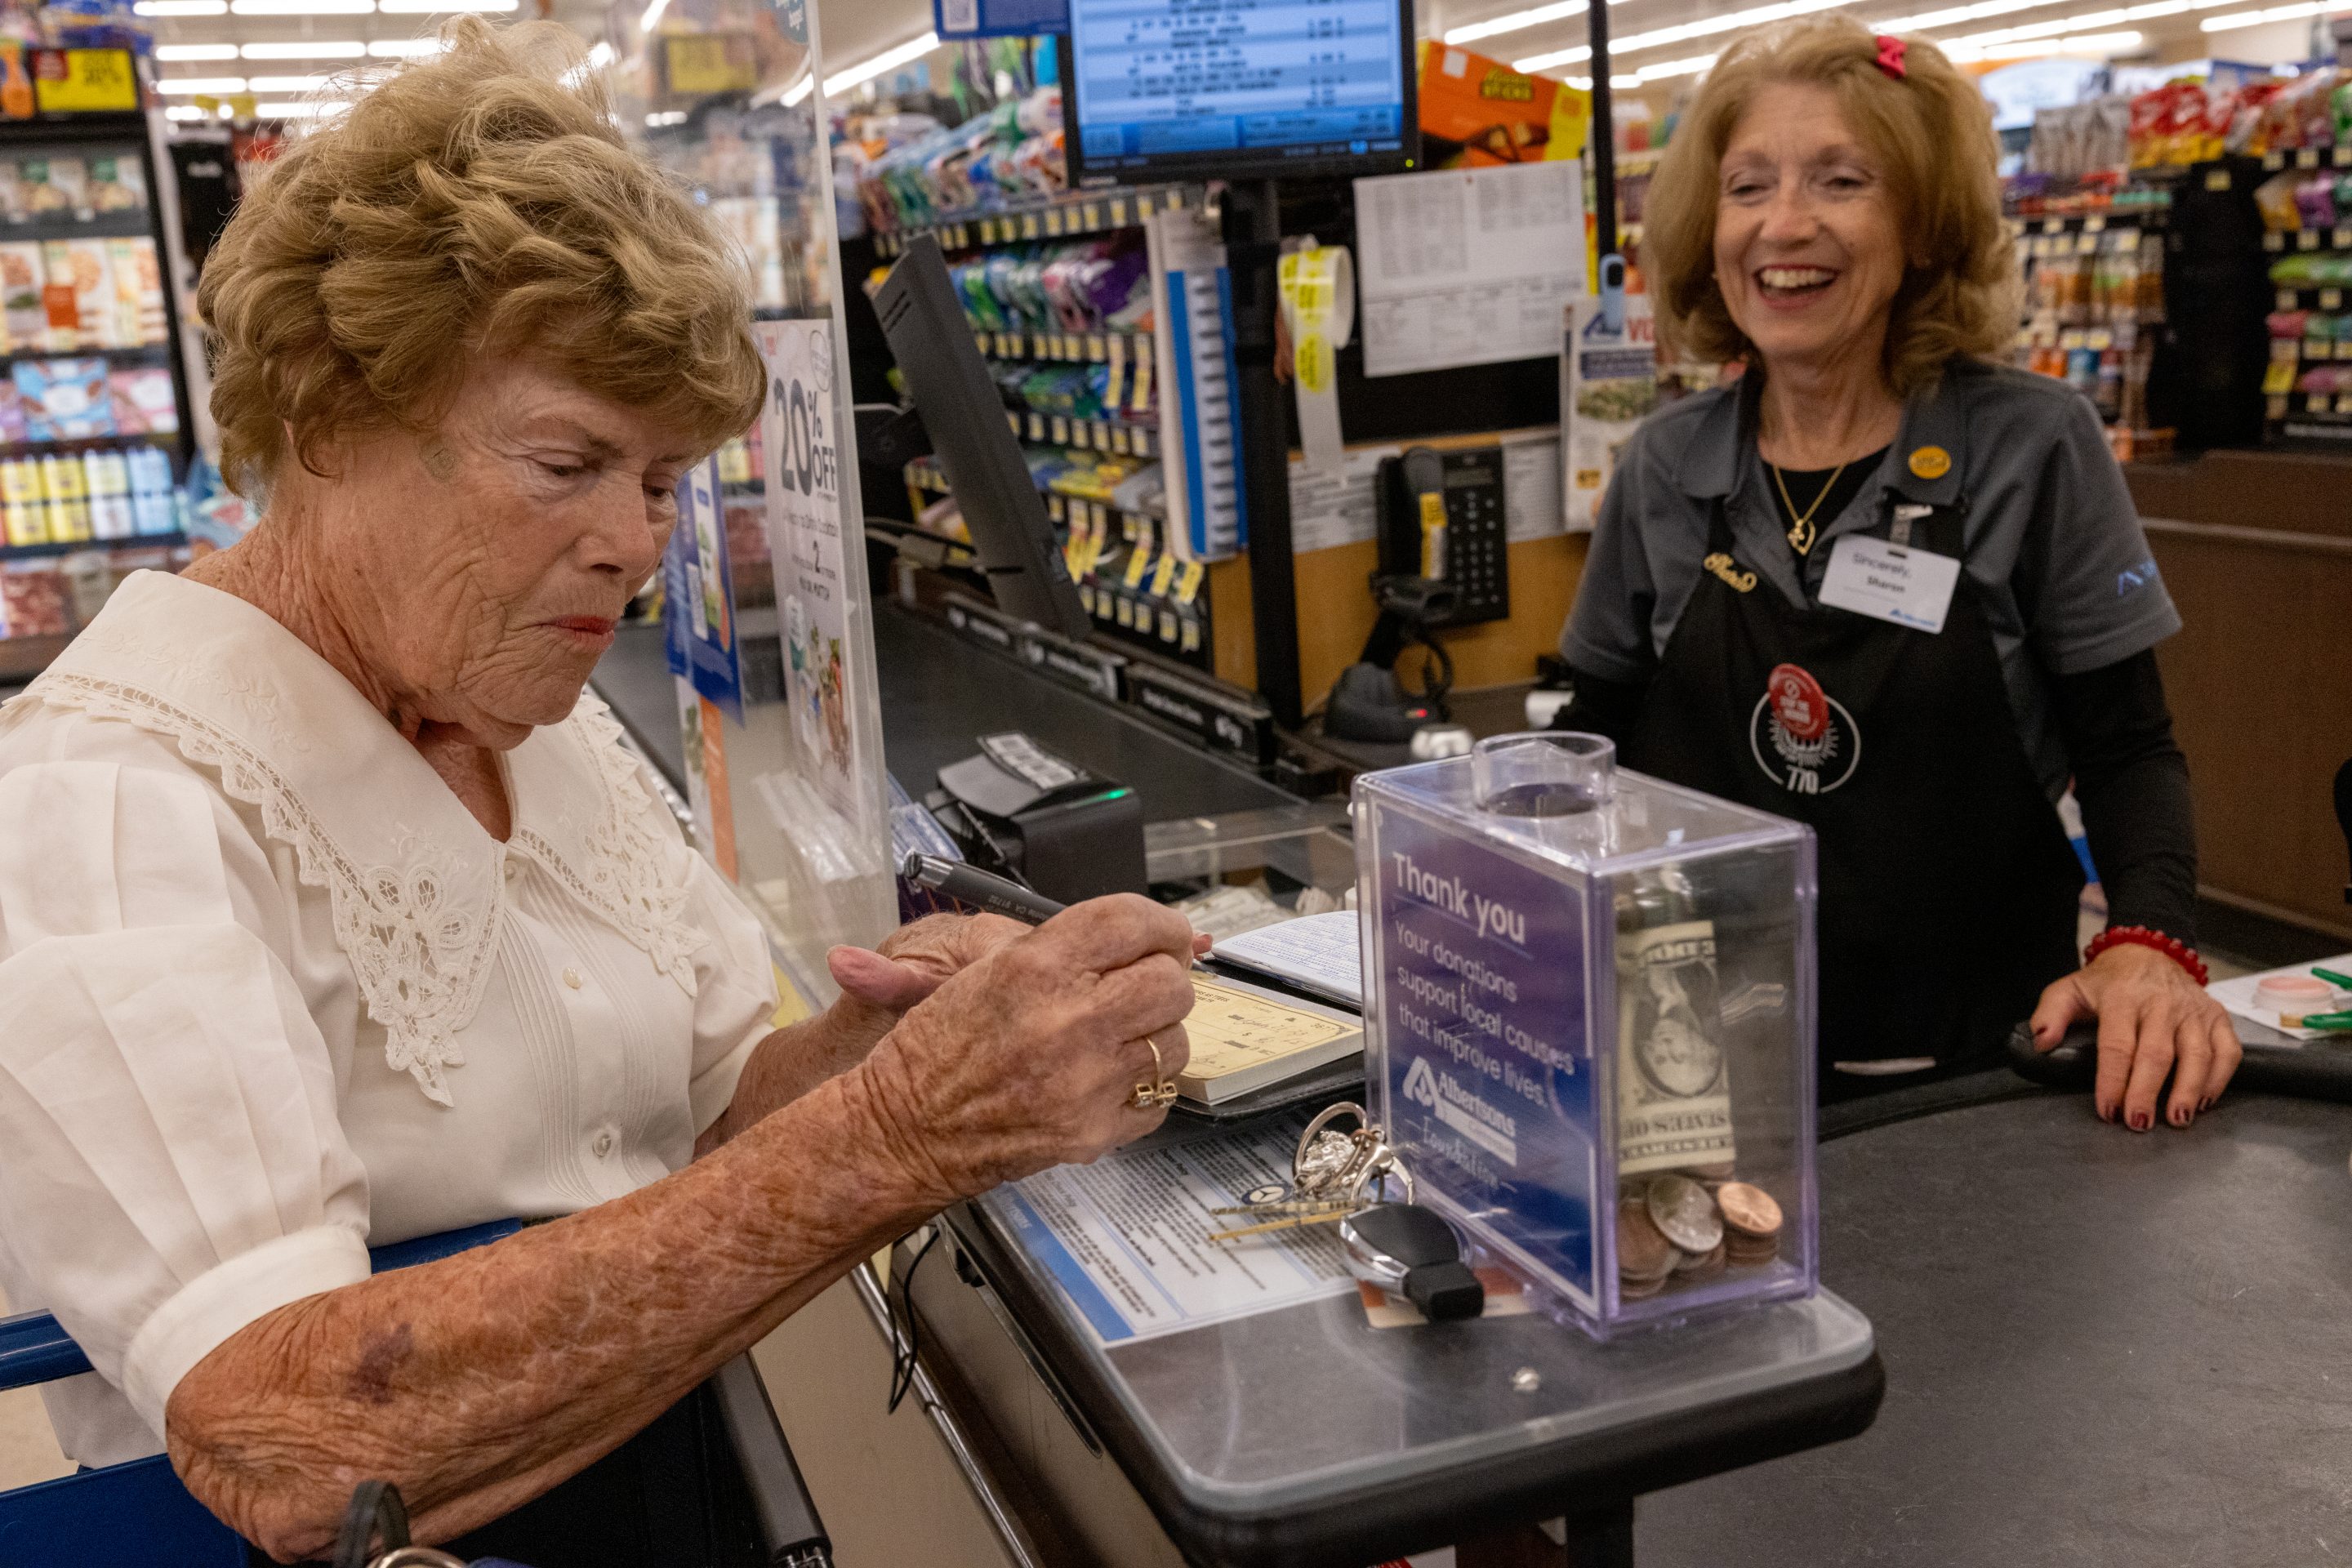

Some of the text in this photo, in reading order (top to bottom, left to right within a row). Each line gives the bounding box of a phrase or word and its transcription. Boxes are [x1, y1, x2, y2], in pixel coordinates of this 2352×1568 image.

[813, 443, 836, 491] OFF
[1867, 575, 1906, 594] Sharon
[1785, 764, 1820, 795] 770
[1392, 851, 1526, 945] Thank you
[1395, 920, 1429, 957] Your
[1432, 942, 1517, 1004] donations
[1397, 966, 1575, 1076] support local causes
[1399, 1002, 1548, 1108] that improve lives.
[1438, 1071, 1517, 1138] Albertsons
